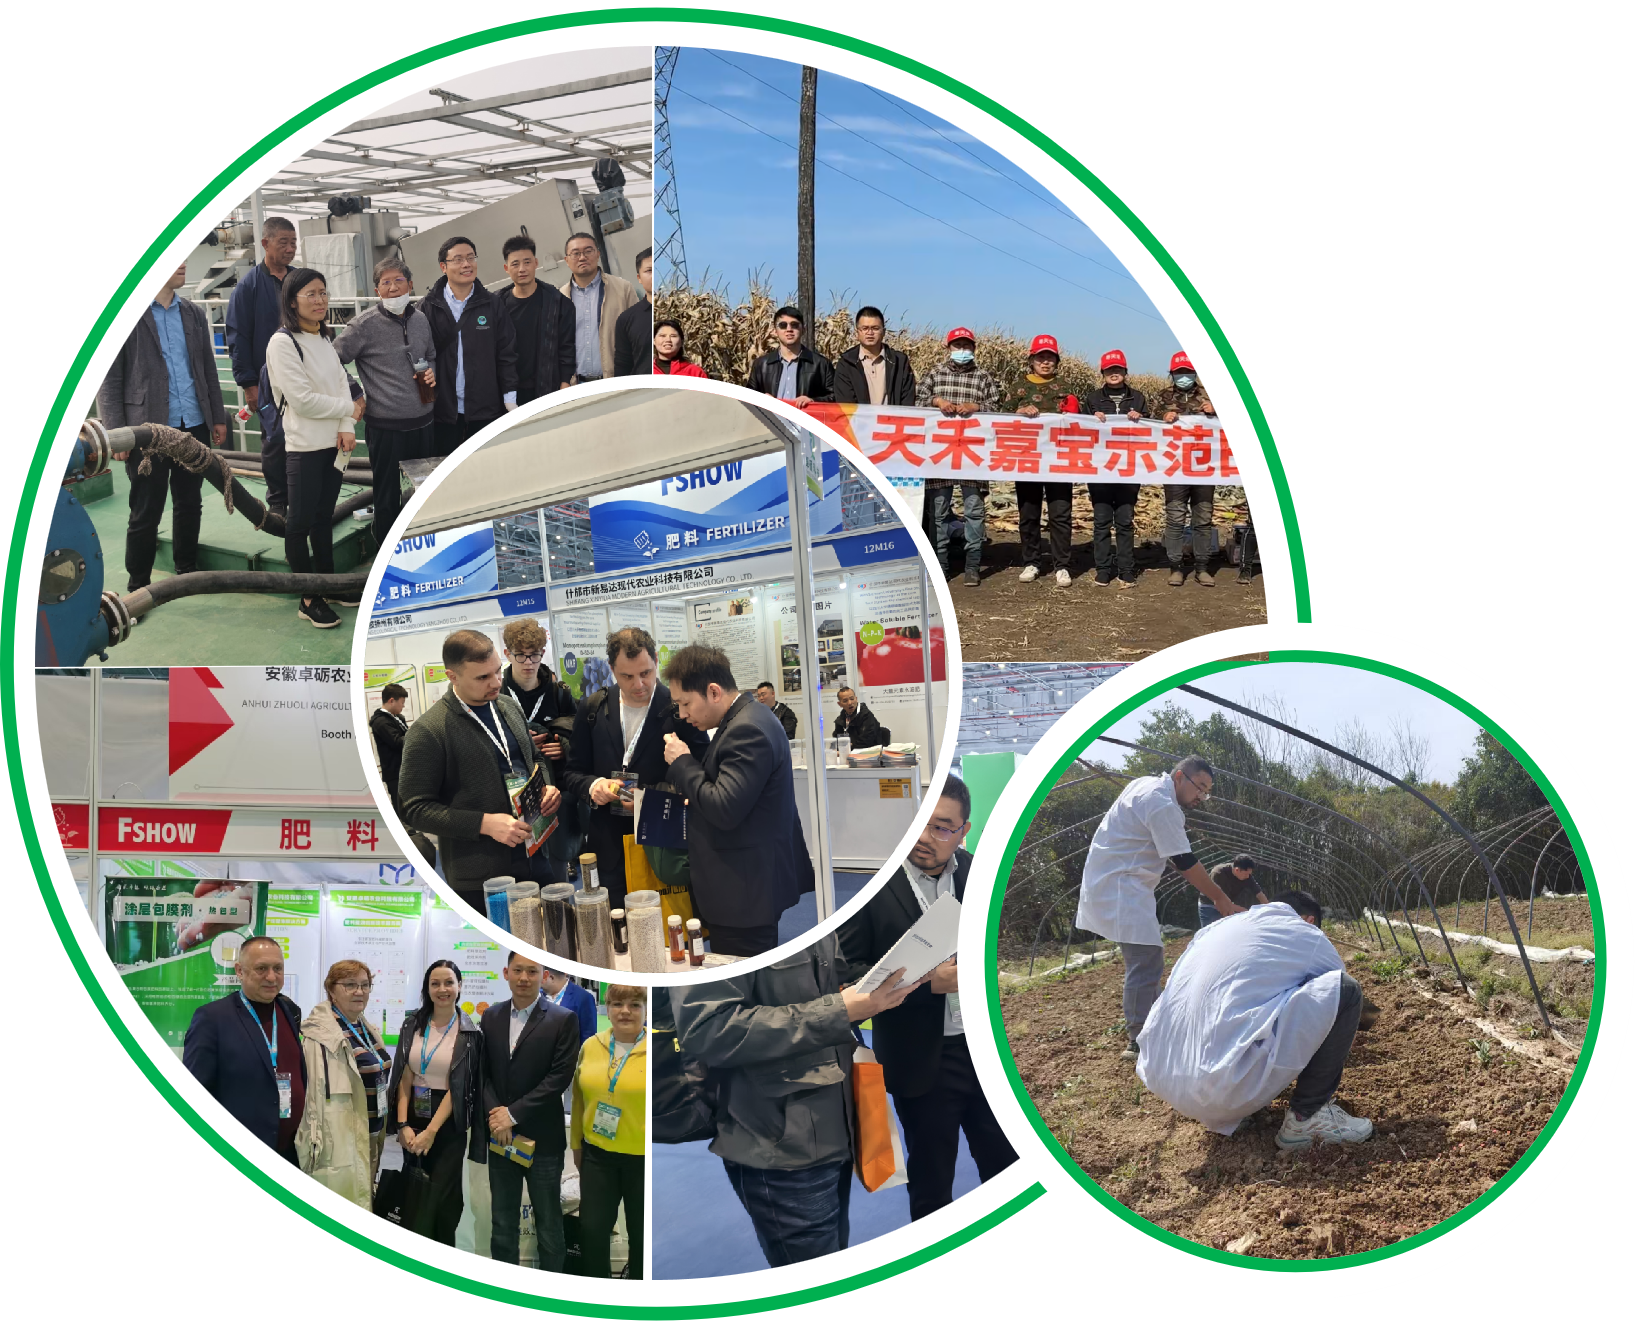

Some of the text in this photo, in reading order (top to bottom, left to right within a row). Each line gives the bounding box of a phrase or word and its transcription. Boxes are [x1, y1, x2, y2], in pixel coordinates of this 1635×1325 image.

[706, 516, 785, 540] FERTILIZER
[864, 541, 895, 554] 12M16
[415, 576, 464, 594] FERTILIZER
[612, 591, 637, 600] MODERN
[637, 584, 681, 597] AGRICULTURAL
[683, 577, 725, 590] TECHNOLOGY
[516, 598, 535, 607] 12M15
[241, 699, 272, 709] ANHUI
[274, 701, 308, 709] ZHUOLI
[321, 730, 352, 739] Booth
[117, 817, 197, 844] FSHOW
